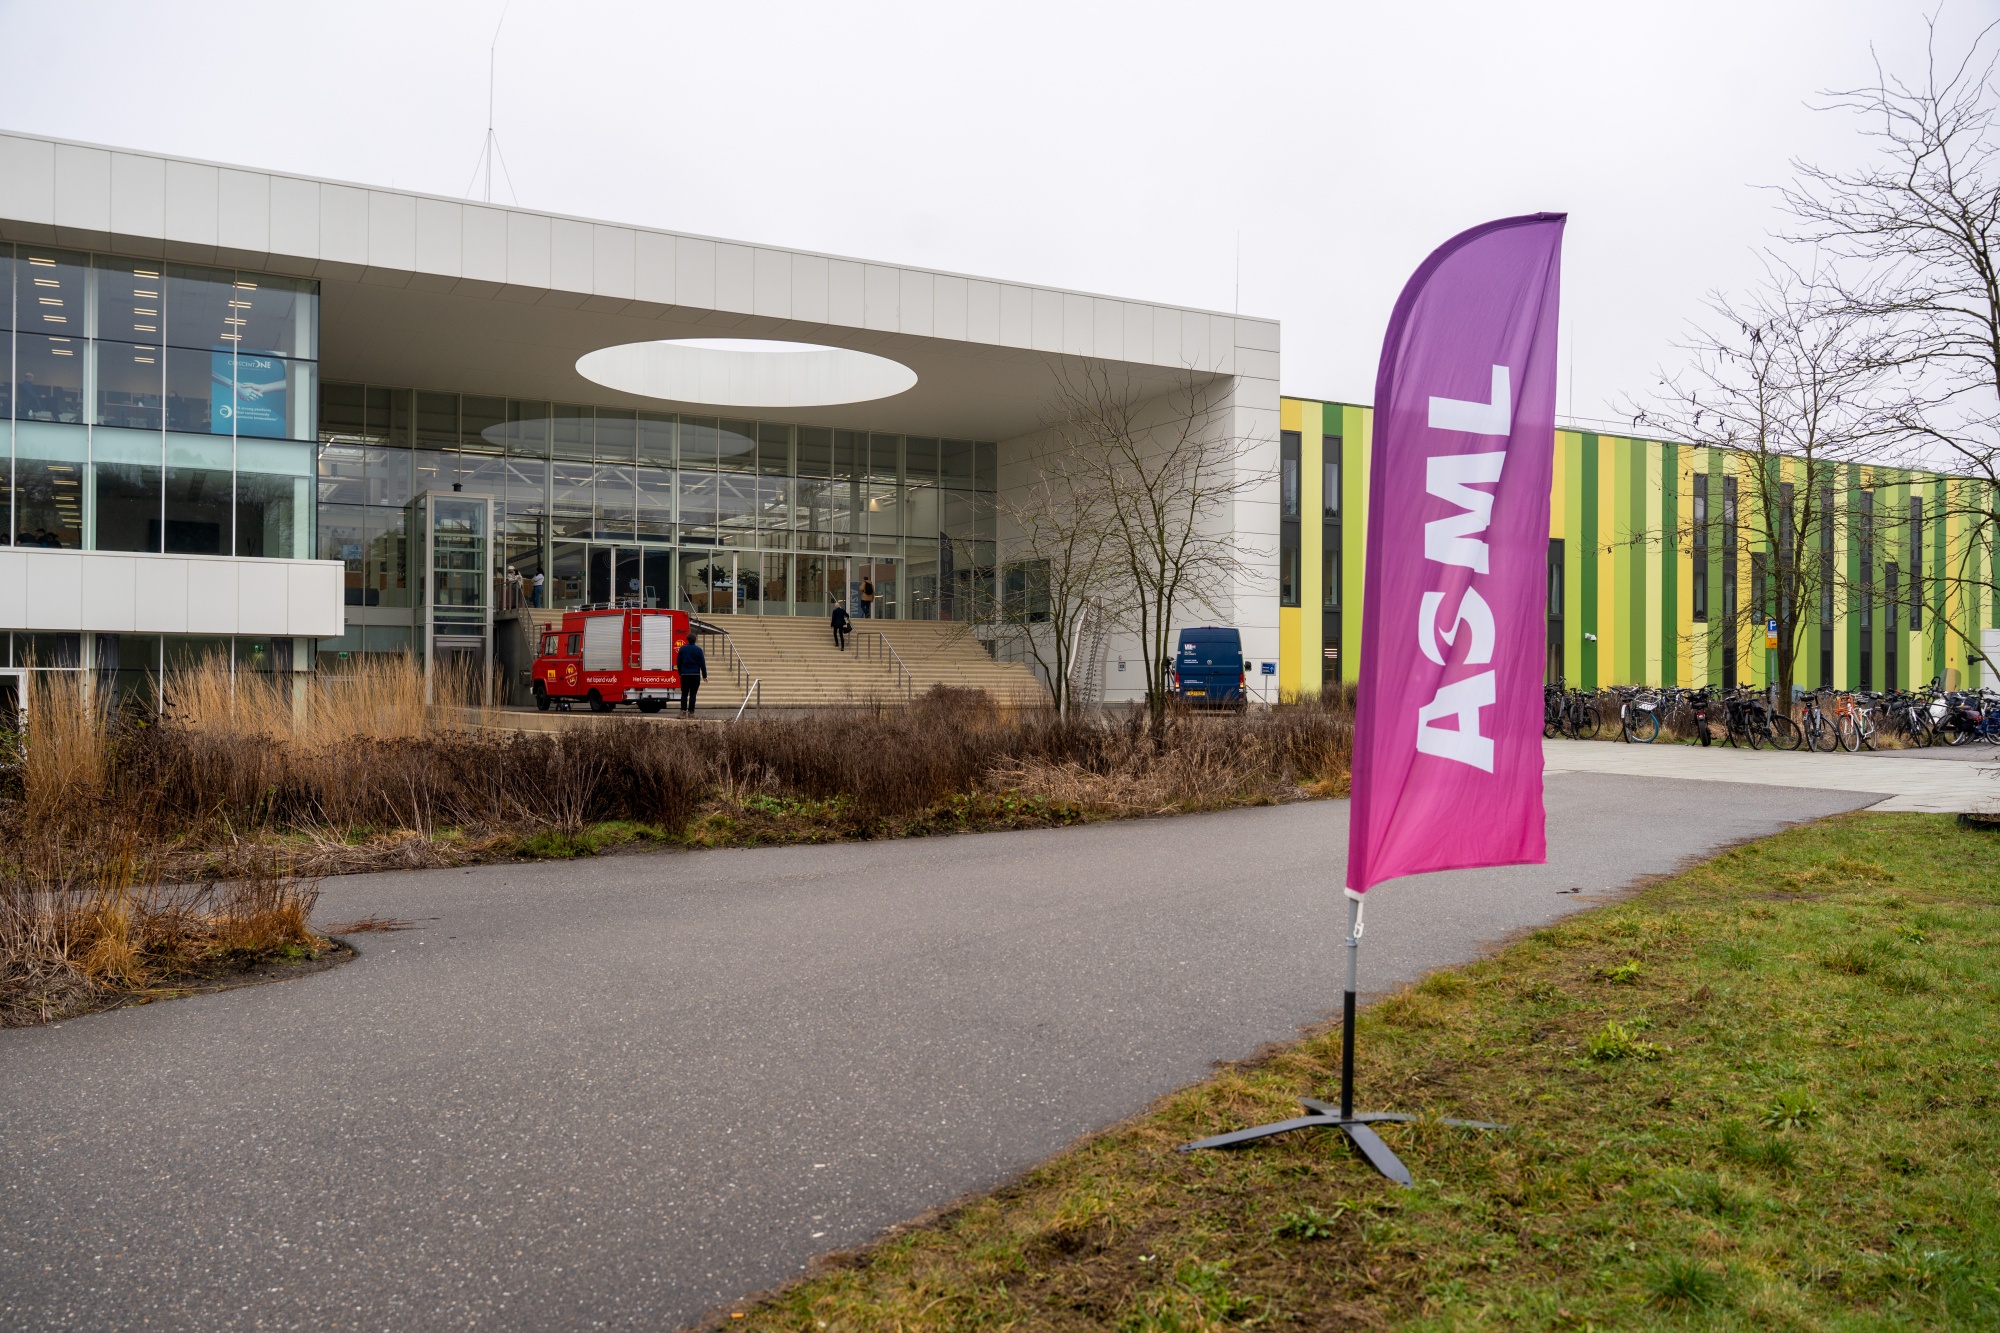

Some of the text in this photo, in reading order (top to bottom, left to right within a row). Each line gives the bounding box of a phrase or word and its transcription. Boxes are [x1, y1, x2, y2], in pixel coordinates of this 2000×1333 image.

[1416, 364, 1511, 774] ASML
[1769, 620, 1778, 631] P
[593, 676, 606, 684] lopend
